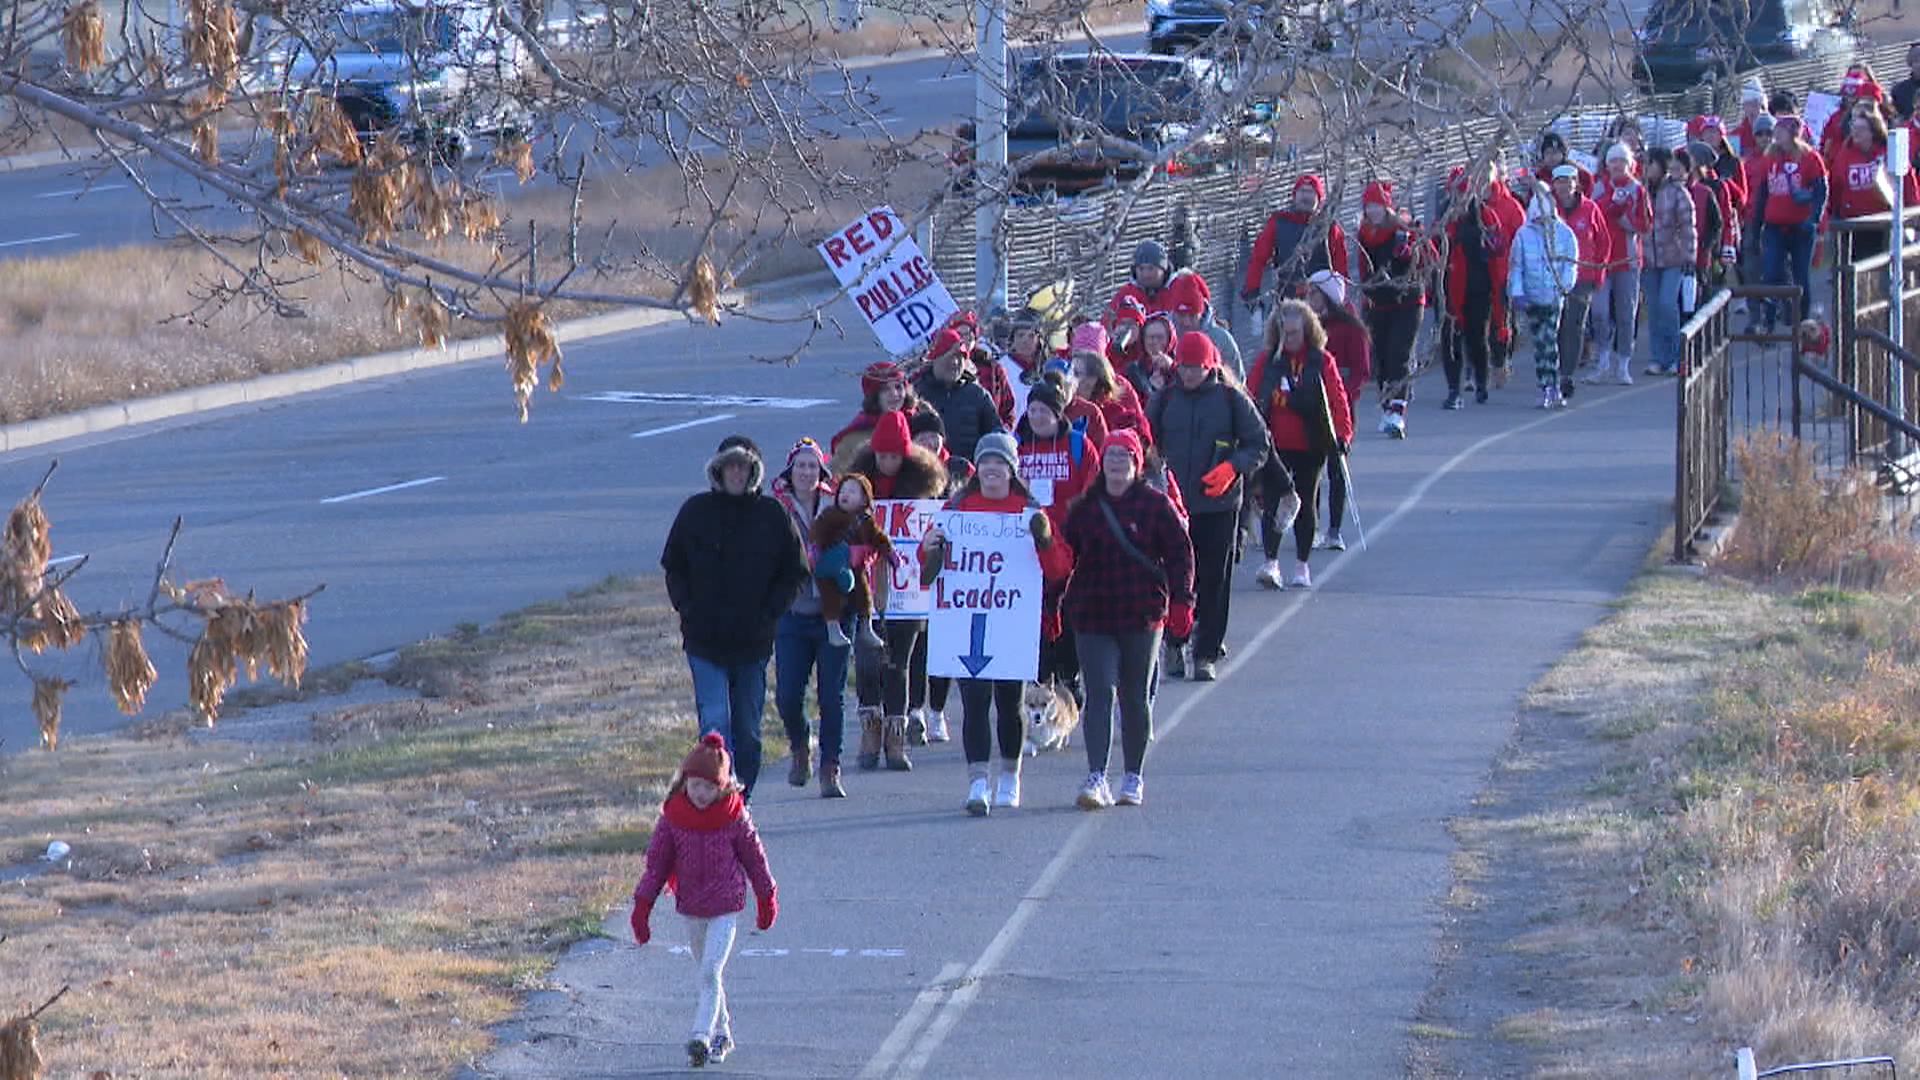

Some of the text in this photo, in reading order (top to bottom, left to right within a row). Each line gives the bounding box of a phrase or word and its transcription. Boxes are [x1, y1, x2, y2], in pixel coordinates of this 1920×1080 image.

[823, 211, 893, 268] RED
[855, 255, 932, 320] PUBLIC
[947, 513, 989, 537] Class
[943, 541, 1004, 574] Line
[936, 576, 1021, 610] Leader
